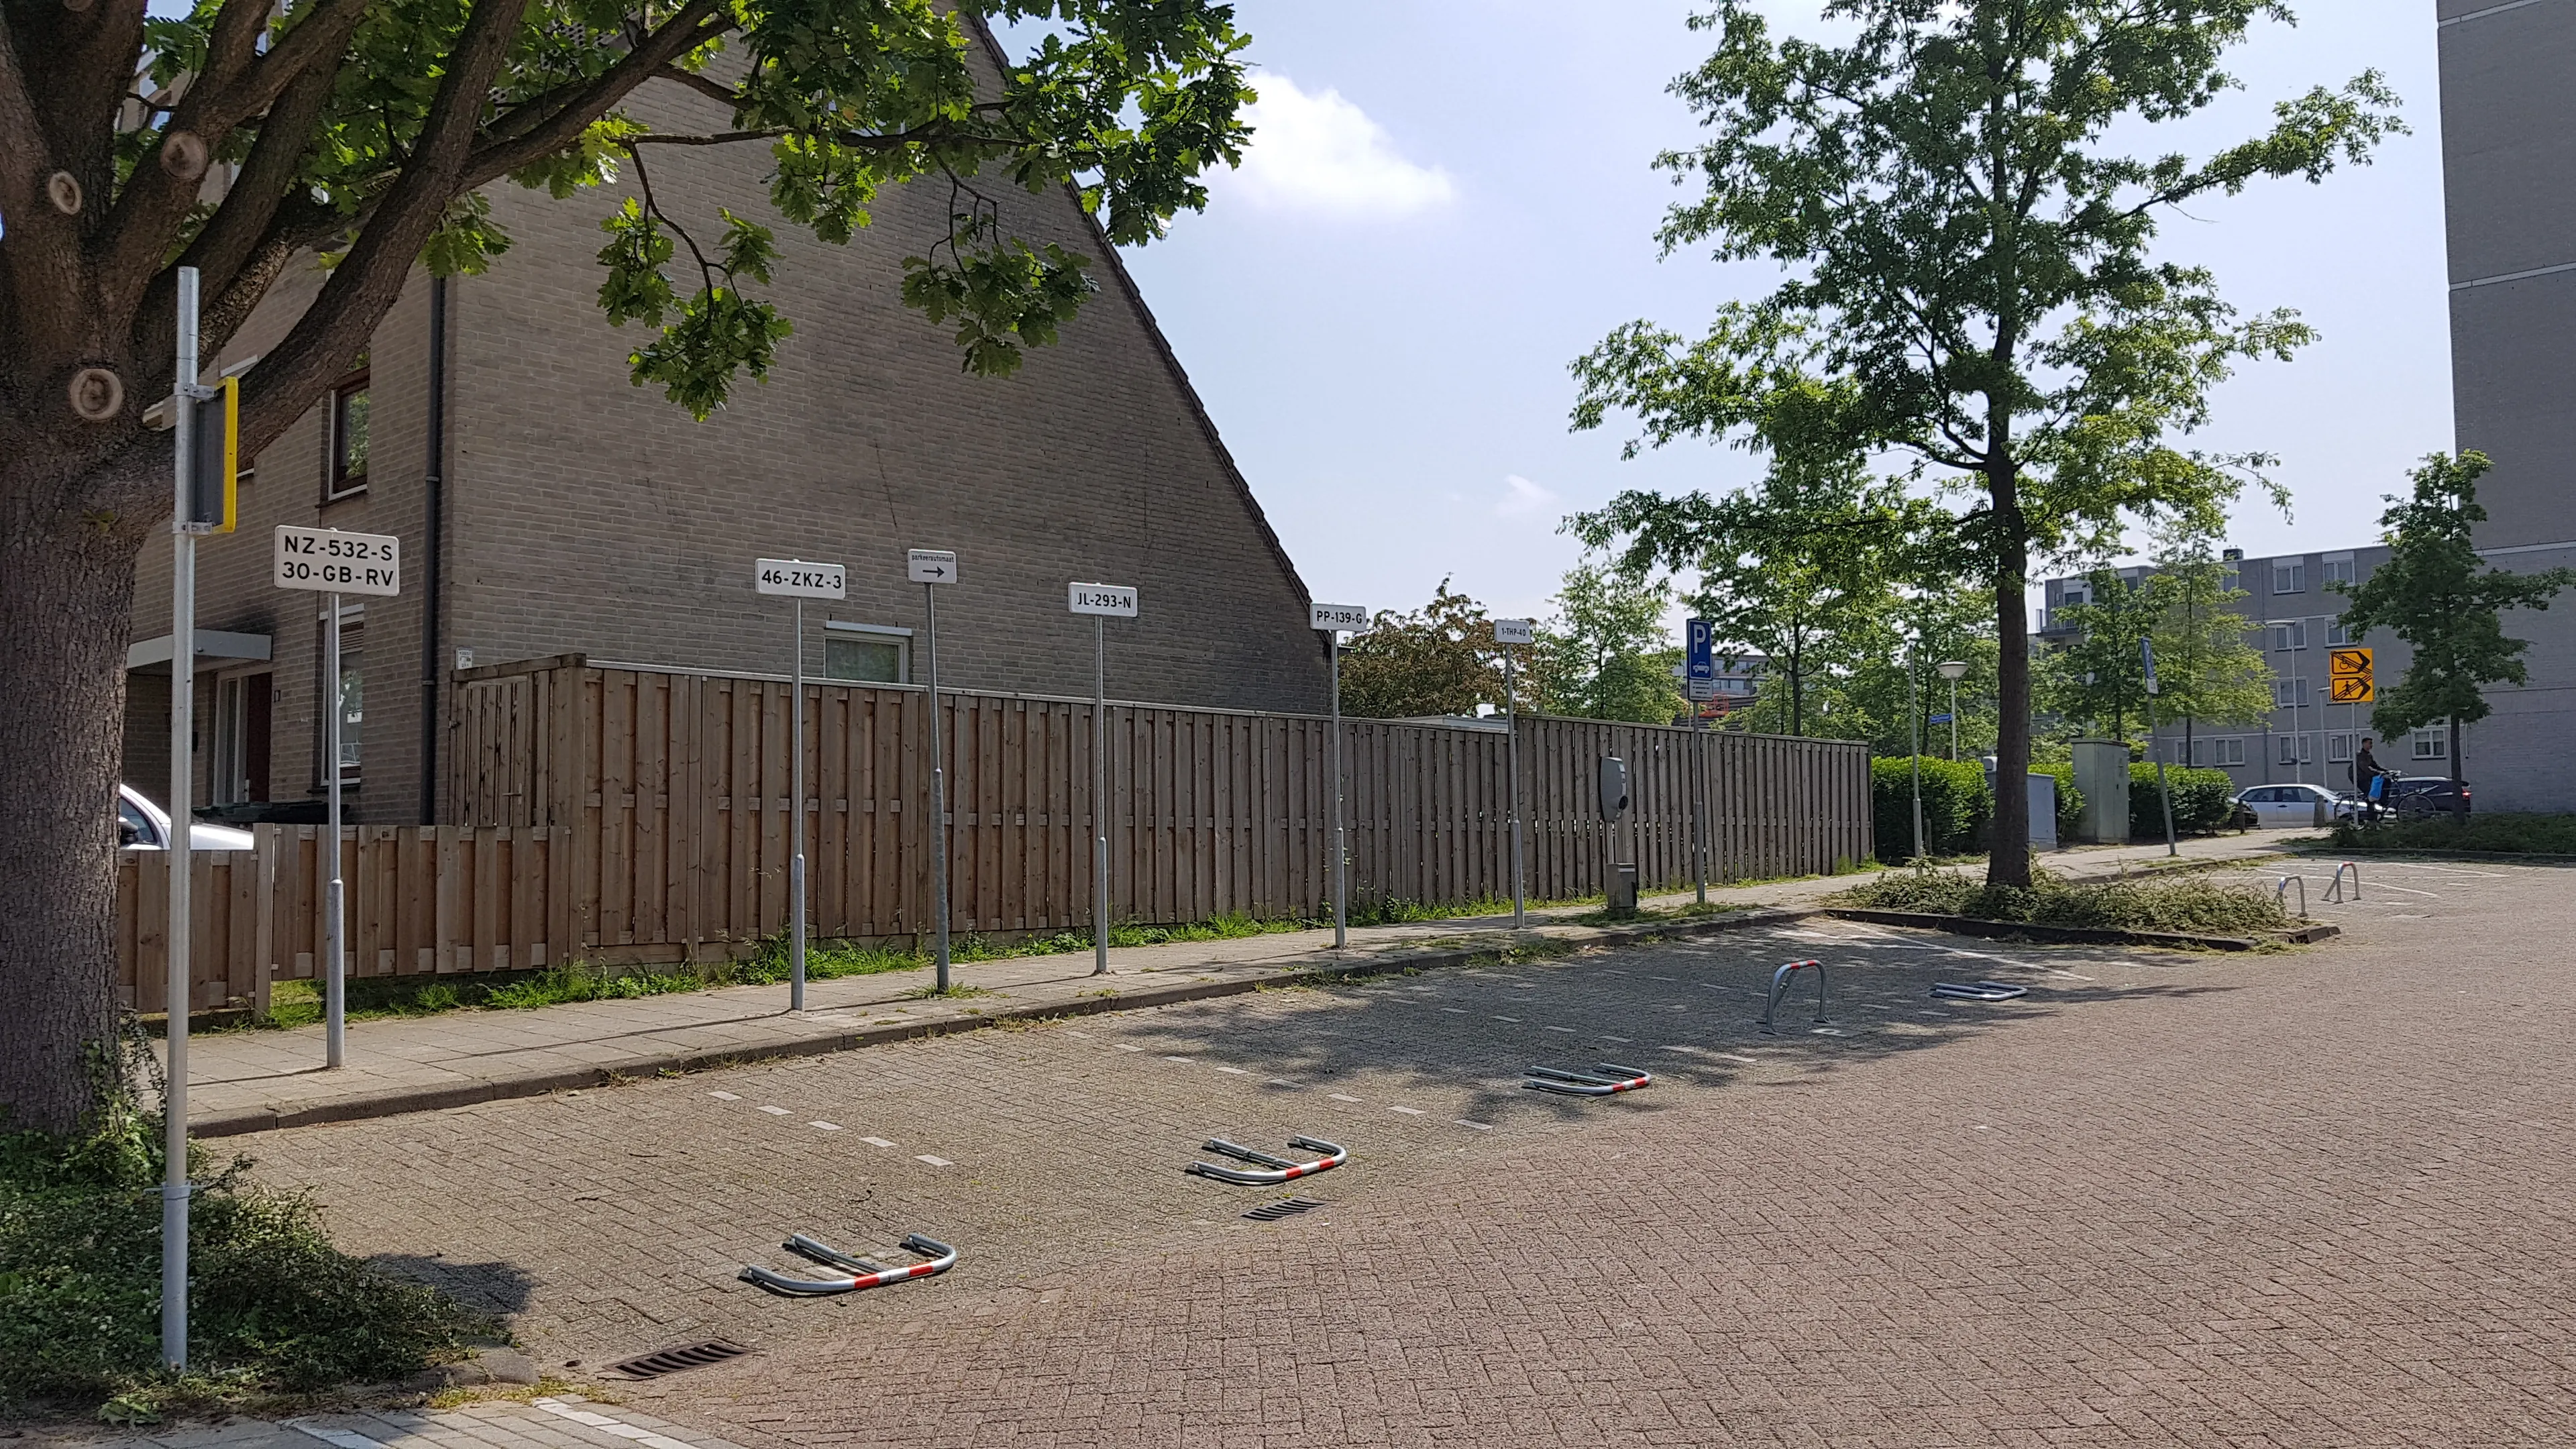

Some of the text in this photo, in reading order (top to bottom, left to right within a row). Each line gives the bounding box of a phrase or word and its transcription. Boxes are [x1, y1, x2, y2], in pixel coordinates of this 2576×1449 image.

[284, 535, 392, 561] NZ-532-S
[912, 555, 954, 563] parkeerautomaat
[282, 561, 394, 586] 30-GB-RV
[761, 570, 842, 589] 46-ZKZ-3
[1077, 592, 1131, 608] JL-293-N
[1317, 610, 1362, 624] PP-139-G
[1501, 627, 1526, 637] 1-THP-40
[1694, 624, 1707, 653] P
